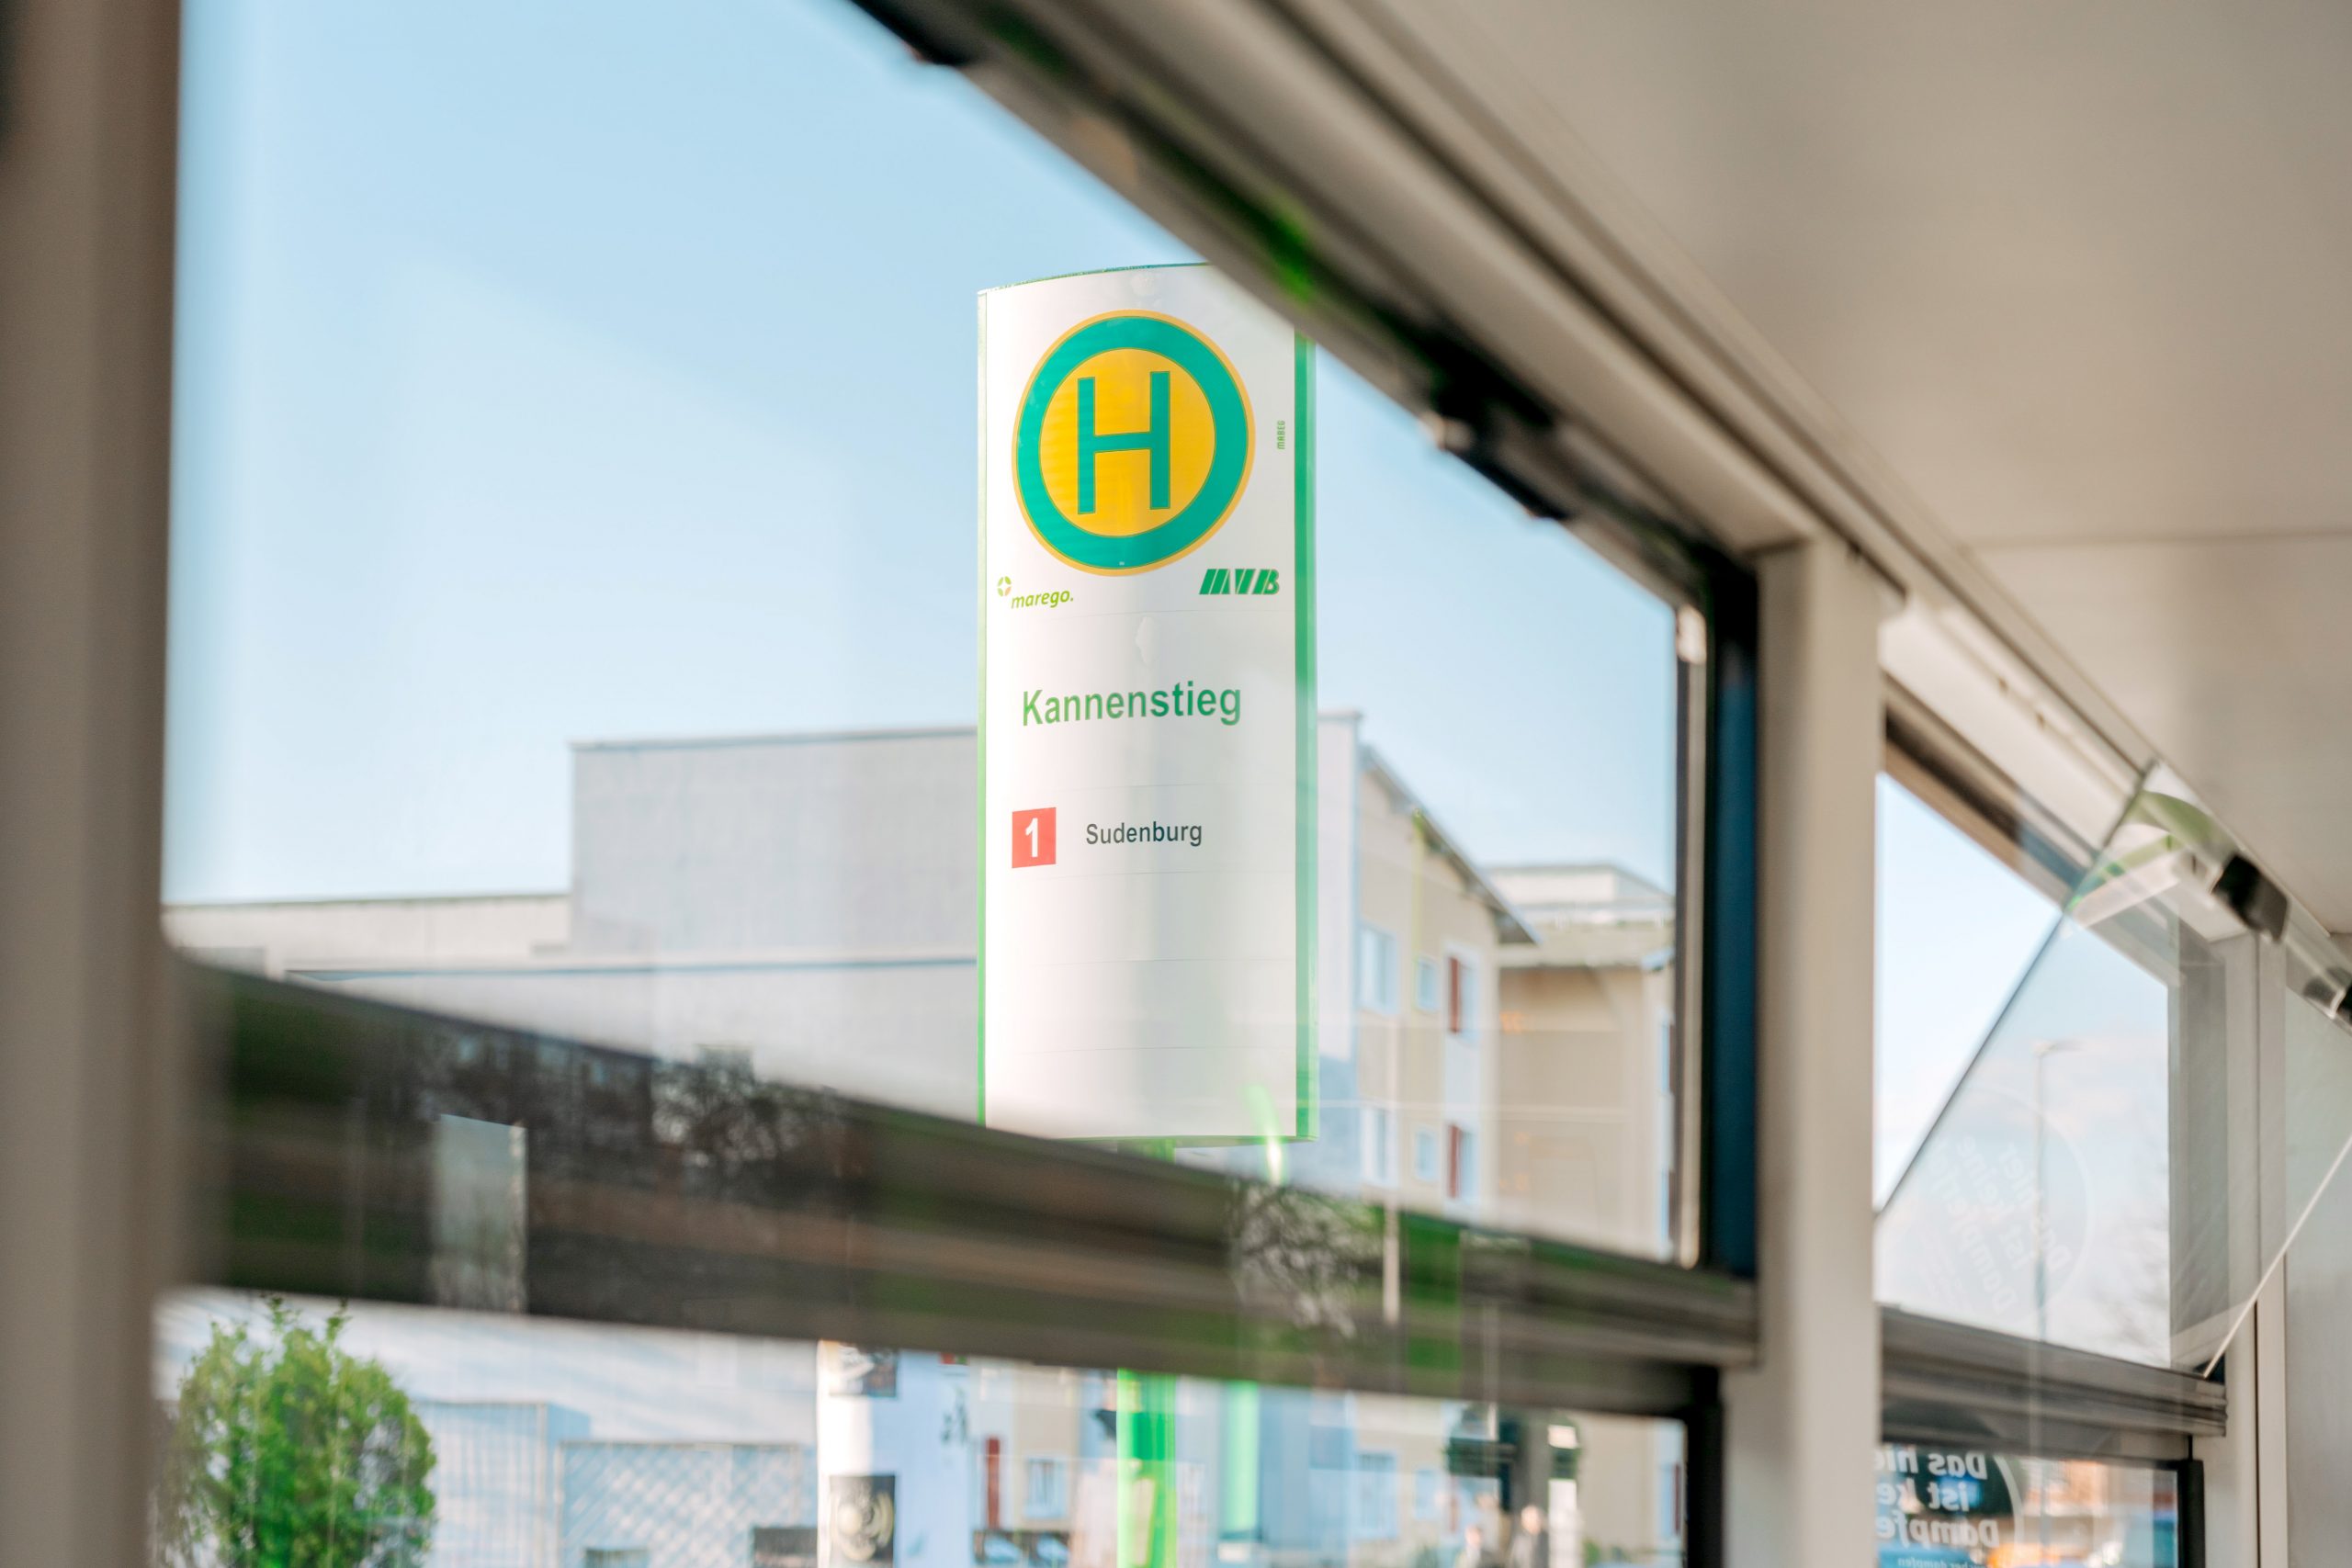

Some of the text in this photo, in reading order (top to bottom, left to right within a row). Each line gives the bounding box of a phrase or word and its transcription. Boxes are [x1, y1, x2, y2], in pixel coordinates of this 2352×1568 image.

[1077, 370, 1171, 515] H
[1276, 419, 1287, 451] MABEG
[1199, 568, 1280, 595] MVB
[1022, 680, 1242, 727] Kannenstieg
[1024, 818, 1203, 858] 1 Sudenburg
